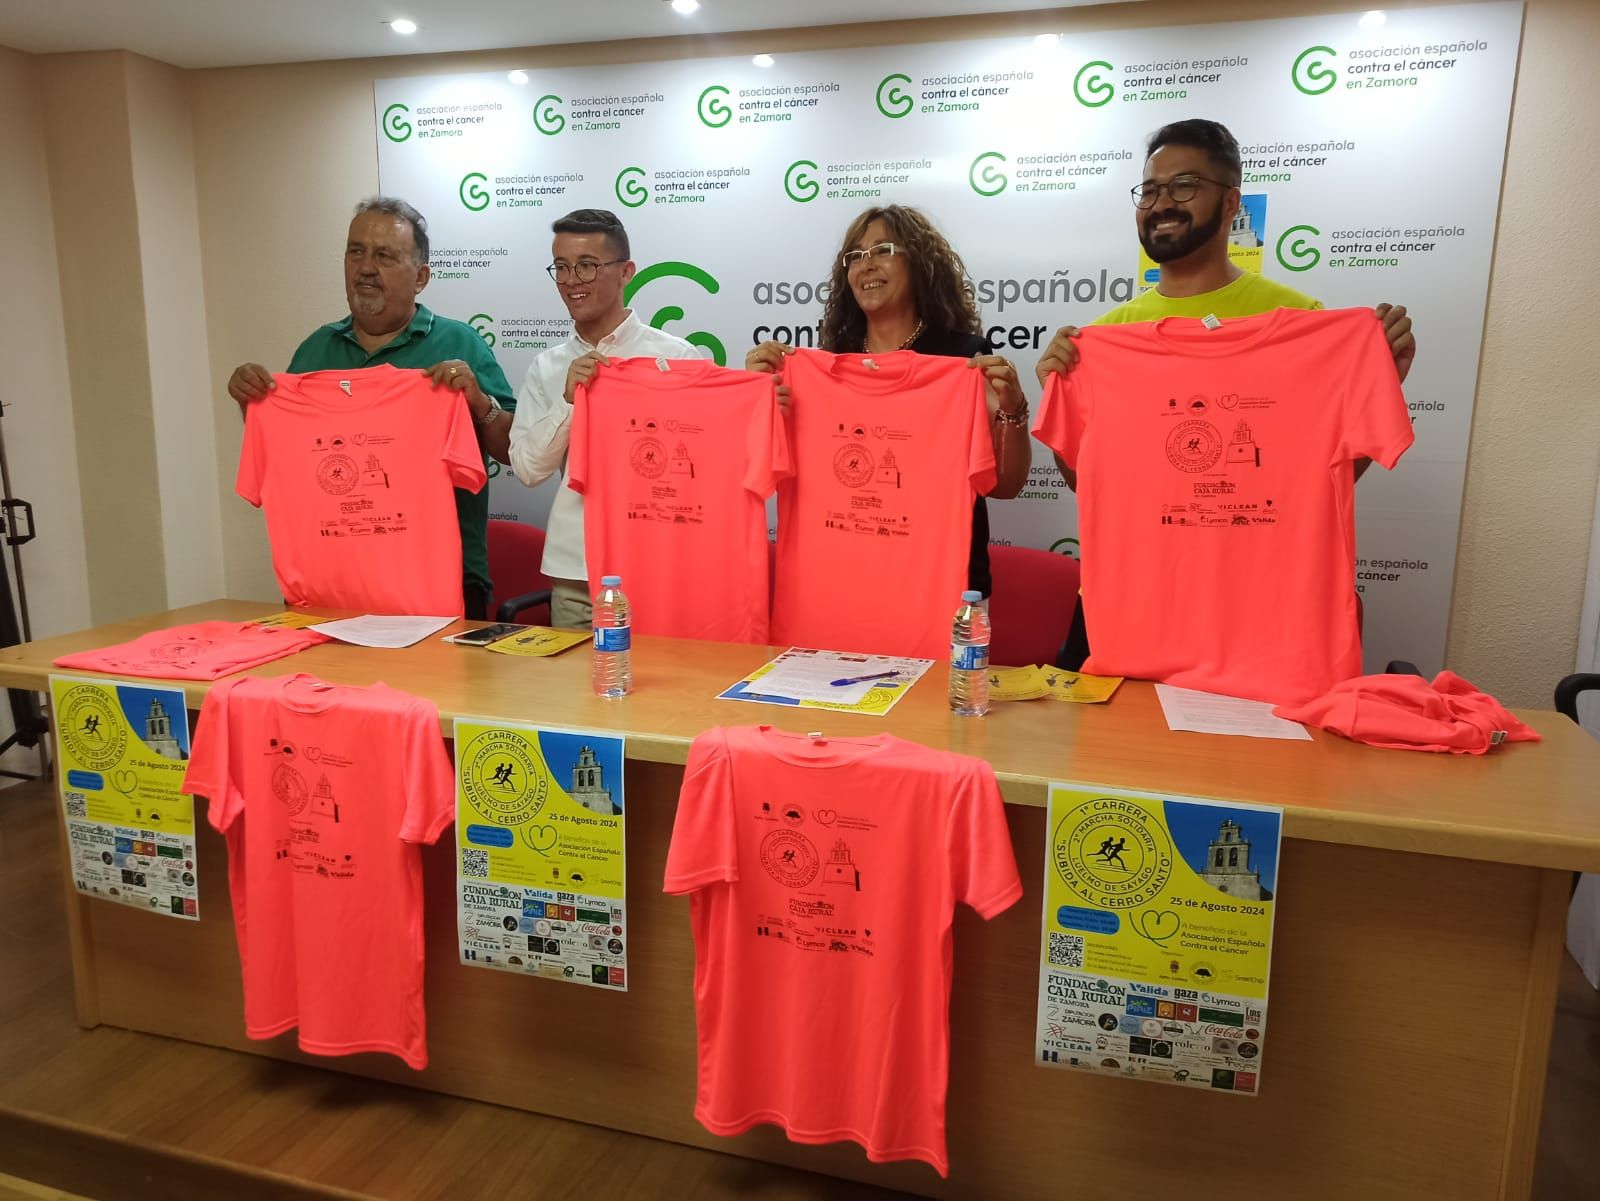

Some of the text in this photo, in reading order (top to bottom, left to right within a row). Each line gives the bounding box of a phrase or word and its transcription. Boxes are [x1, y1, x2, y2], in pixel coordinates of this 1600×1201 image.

[1349, 40, 1488, 59] asociación española
[1124, 56, 1249, 73] asociación española
[1347, 62, 1391, 74] contra
[1393, 60, 1406, 71] el
[922, 71, 1034, 86] asociación española
[1123, 76, 1162, 87] contra
[1165, 74, 1176, 85] el
[1346, 77, 1418, 89] en Zamora
[739, 82, 840, 97] asociación española
[921, 89, 957, 99] contra
[959, 88, 969, 97] el
[571, 93, 664, 106] asociación española
[1122, 90, 1187, 101] en Zamora
[739, 100, 771, 110] contra
[773, 99, 781, 108] el
[921, 102, 980, 113] en Zamora
[571, 109, 600, 118] contra
[603, 108, 611, 117] el
[739, 113, 792, 123] en Zamora
[418, 116, 454, 126] contra el
[571, 121, 621, 131] en Zamora
[418, 128, 463, 138] en Zamora
[1296, 140, 1355, 154] española
[1017, 150, 1132, 164] asociación española
[1241, 156, 1327, 168] ntra el cáncer
[827, 159, 932, 172] asociación española
[654, 166, 750, 179] asociación española
[1016, 168, 1052, 178] contra
[1055, 167, 1065, 176] el
[1243, 172, 1291, 182] Zamora
[826, 176, 860, 185] contra
[862, 174, 871, 184] el
[495, 187, 523, 195] contra
[526, 186, 533, 194] el
[654, 182, 685, 191] contra
[687, 181, 696, 190] el
[1015, 181, 1076, 191] en Zamora
[654, 194, 705, 203] en Zamora
[826, 188, 881, 198] en Zamora
[496, 198, 543, 207] en Zamora
[1332, 226, 1465, 239] asociación española
[1330, 243, 1372, 253] contra
[1375, 242, 1387, 252] el
[430, 260, 451, 268] ontra
[453, 260, 461, 268] el
[1329, 257, 1398, 267] en Zamora
[437, 271, 470, 279] Zamora
[501, 329, 529, 337] contra
[530, 329, 539, 337] el
[985, 325, 1047, 350] cer
[514, 340, 547, 349] Zamora
[1039, 478, 1048, 487] el
[1370, 559, 1429, 570] española
[1357, 571, 1400, 582] cáncer
[487, 732, 528, 750] CARRERA
[482, 809, 530, 824] AL CERRO
[1093, 800, 1148, 823] CARRERA
[570, 816, 598, 825] Agosto
[600, 819, 618, 827] 2024
[1079, 815, 1154, 853] MARCHA SOLIDARIA
[1072, 857, 1152, 892] LUELMO DE SAYAGO
[463, 894, 522, 909] CAJA RURAL
[524, 888, 606, 907] Valida gaza Lymco
[1080, 889, 1144, 907] AL CERRO
[1170, 897, 1265, 915] 25 de Agosto 2024
[464, 939, 501, 950] VICLEAN
[1180, 940, 1208, 950] Contra
[1047, 984, 1078, 999] CAJA
[1081, 990, 1126, 1007] RURAL
[1129, 982, 1241, 1007] Valida gaza Lymco
[1047, 995, 1090, 1008] DE ZAMORA
[1062, 1016, 1097, 1027] ZAMORA
[1043, 1039, 1092, 1052] VICLEAN
